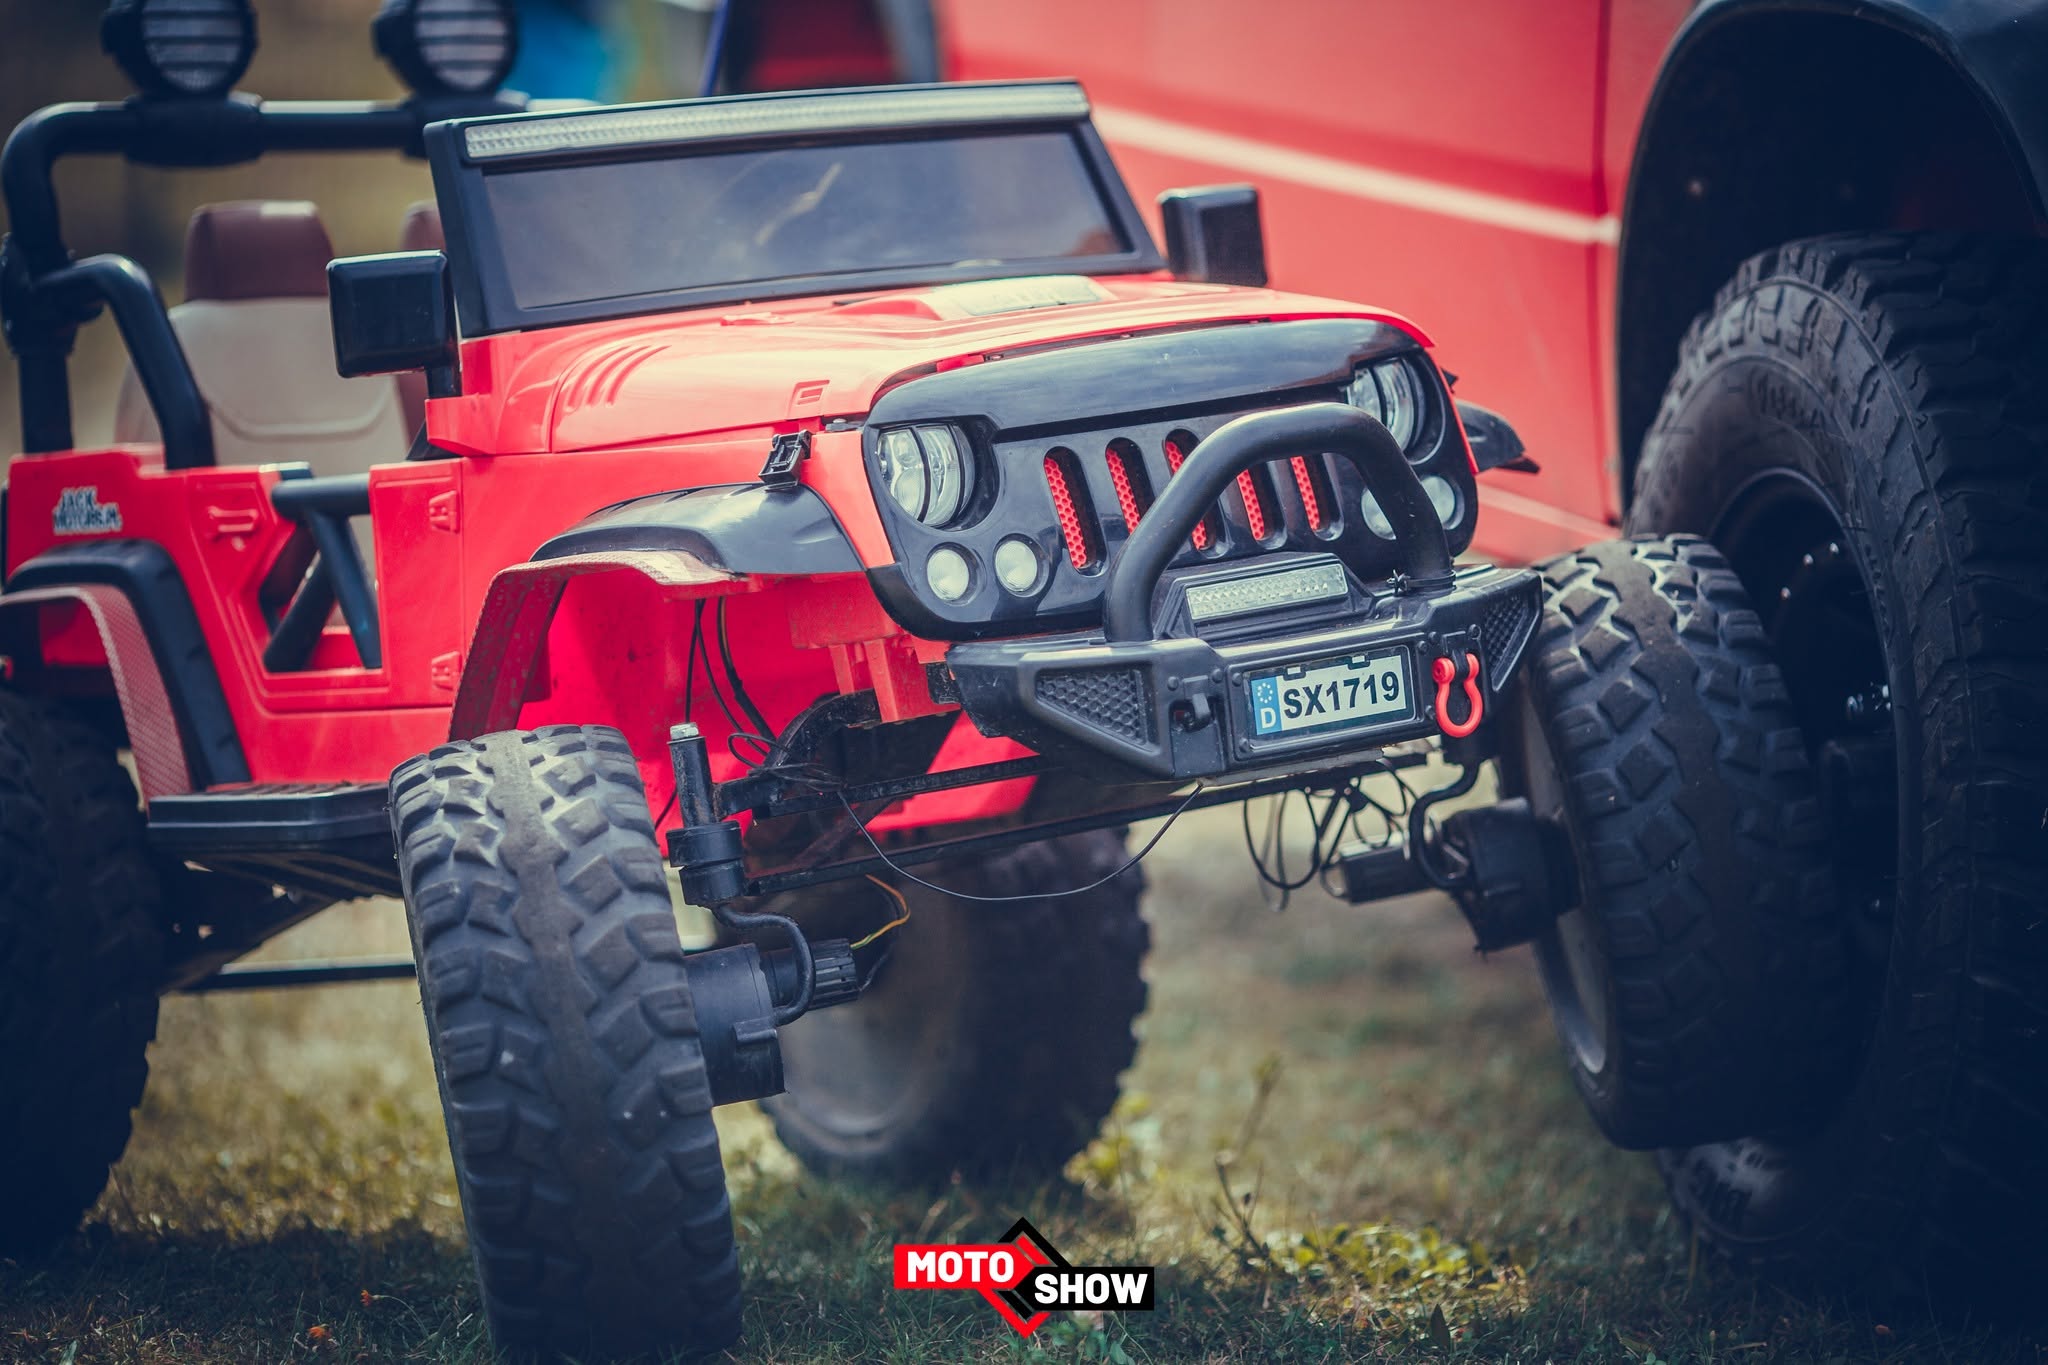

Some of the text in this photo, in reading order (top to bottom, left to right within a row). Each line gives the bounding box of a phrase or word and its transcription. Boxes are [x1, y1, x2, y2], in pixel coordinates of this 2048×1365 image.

[60, 487, 97, 511] JACK
[1283, 671, 1400, 719] SX1719
[1260, 707, 1277, 729] D
